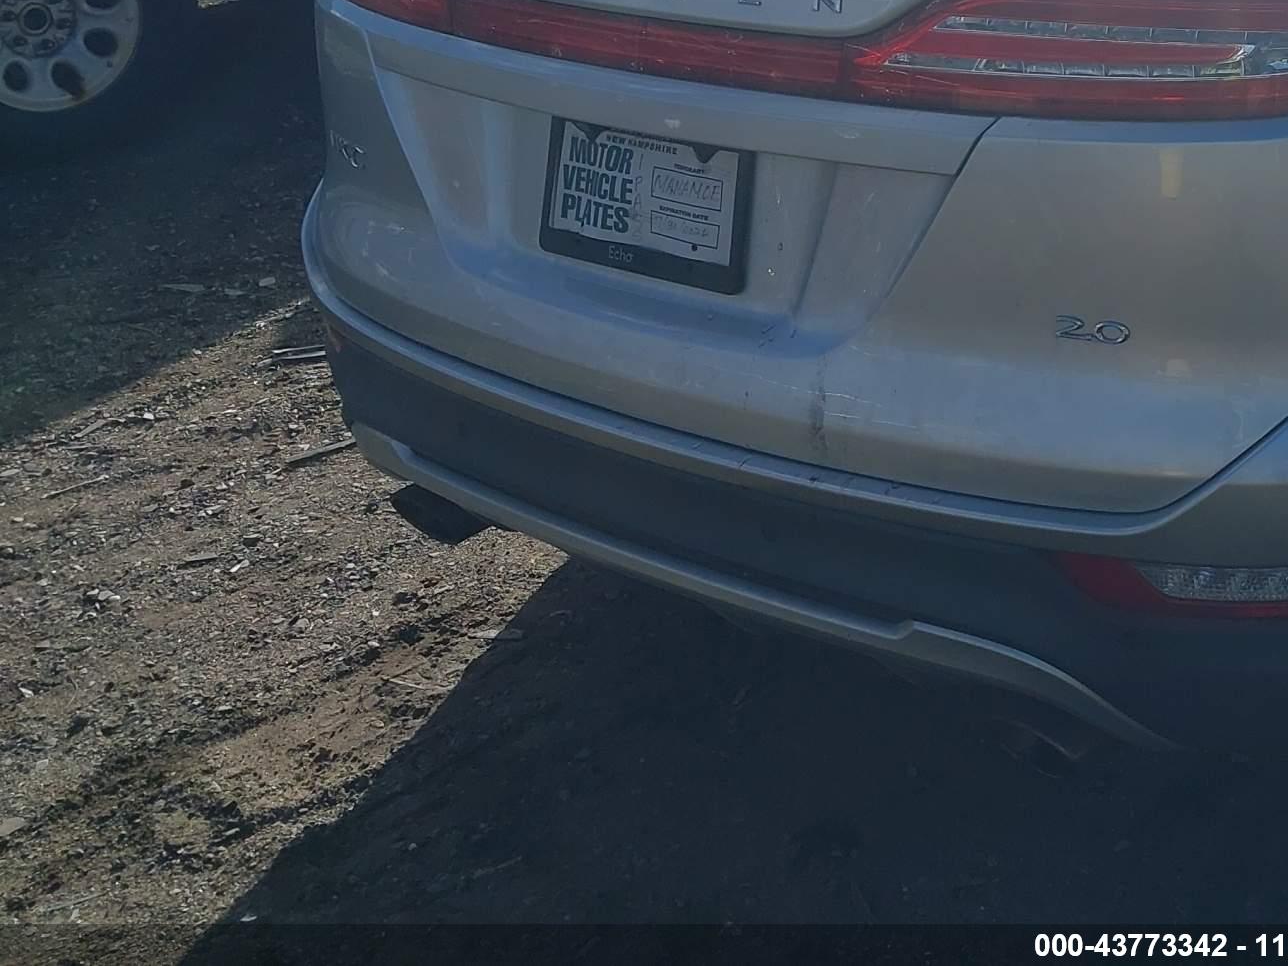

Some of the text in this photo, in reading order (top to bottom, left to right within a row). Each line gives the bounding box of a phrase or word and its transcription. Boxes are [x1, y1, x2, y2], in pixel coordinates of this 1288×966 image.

[569, 136, 634, 175] MOTOR
[606, 134, 678, 155] NEW HAMPSHIRE
[563, 164, 633, 205] VEHICLE
[560, 192, 629, 234] PLATES
